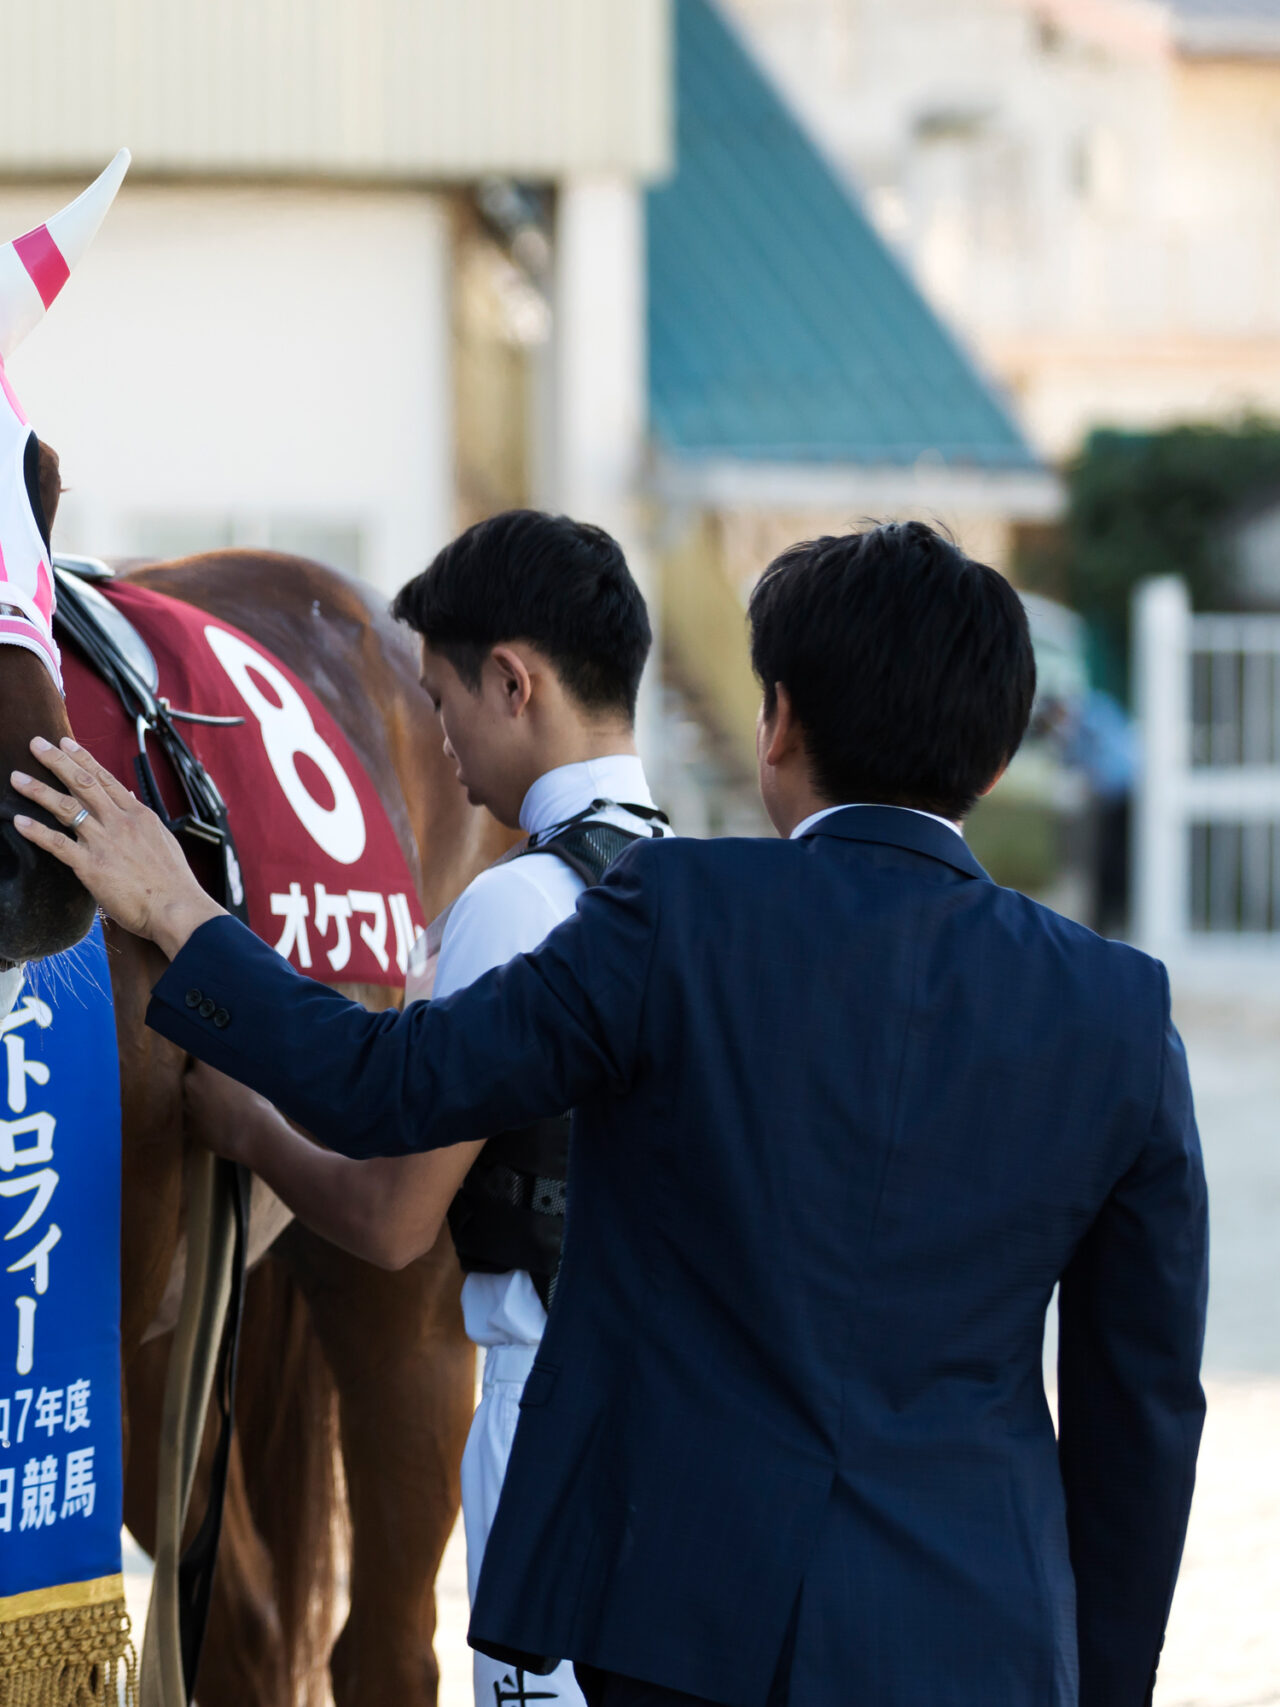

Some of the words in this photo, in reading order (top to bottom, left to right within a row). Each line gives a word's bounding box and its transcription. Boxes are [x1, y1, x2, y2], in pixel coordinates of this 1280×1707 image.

[205, 625, 366, 864] 8
[270, 882, 427, 977] オケマル
